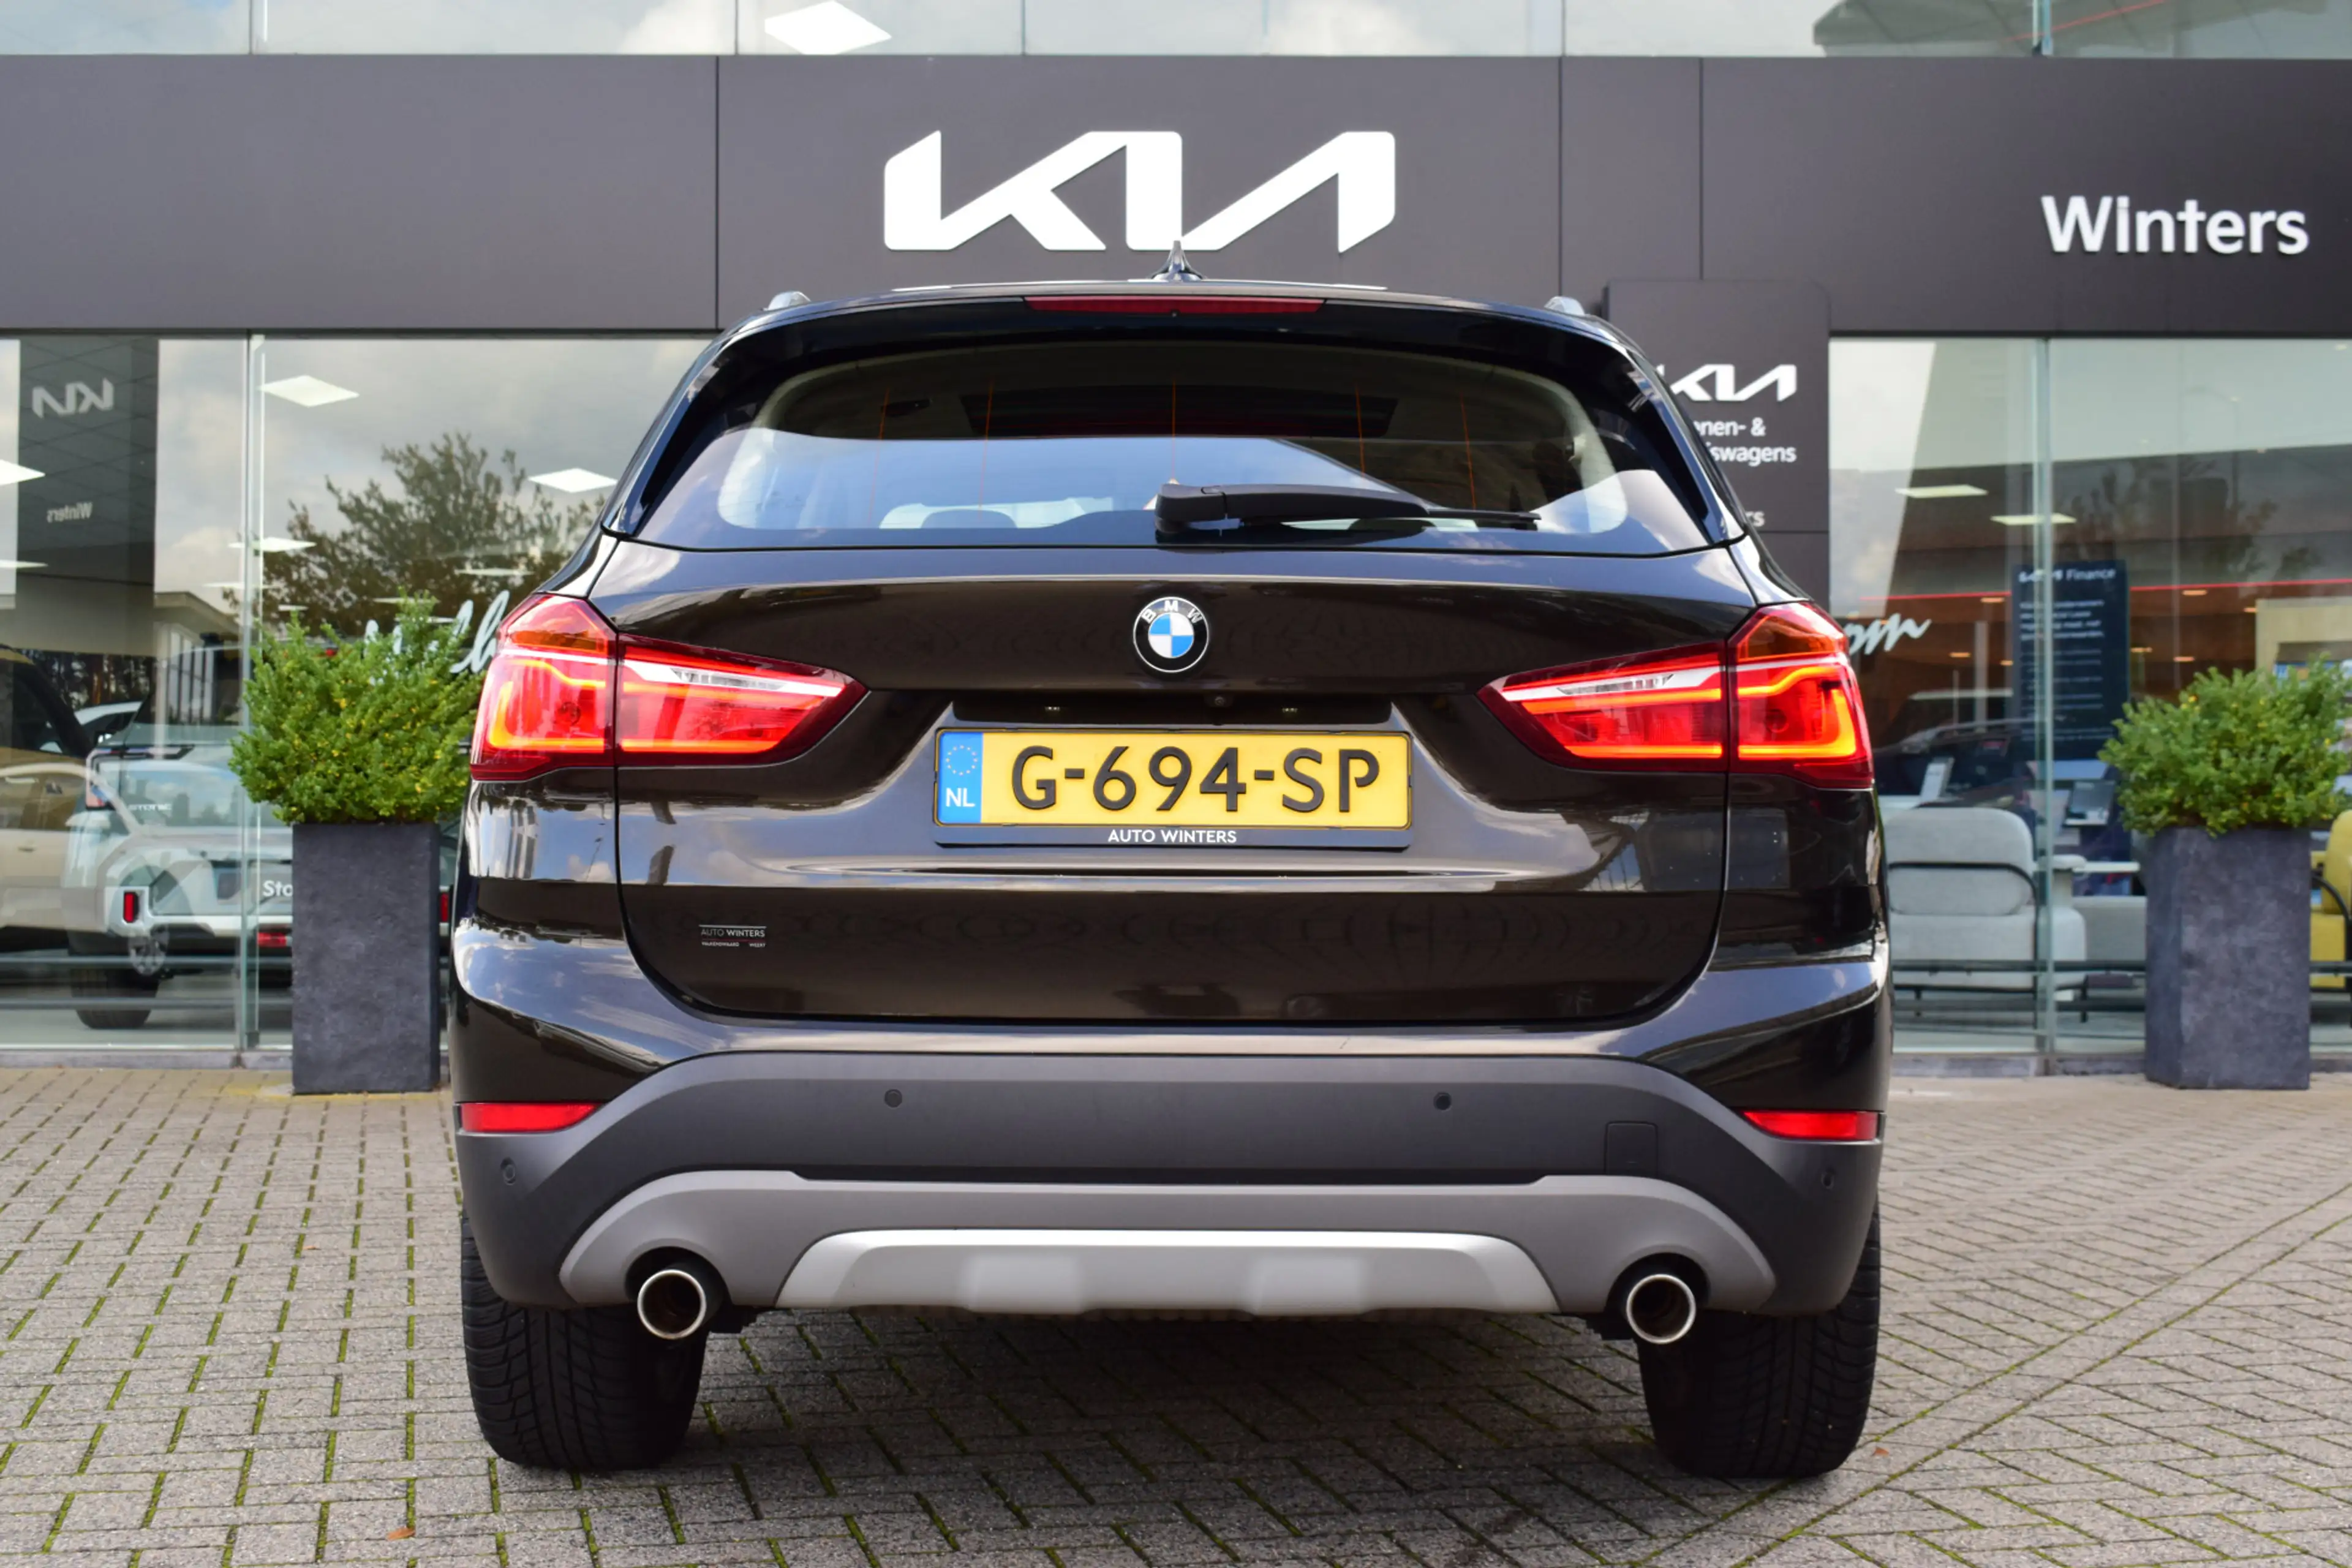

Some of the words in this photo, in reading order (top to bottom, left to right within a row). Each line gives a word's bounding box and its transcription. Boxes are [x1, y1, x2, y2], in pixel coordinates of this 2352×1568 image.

[884, 130, 1395, 253] KIA
[2041, 195, 2310, 255] Winters
[1751, 417, 1766, 437] &
[1706, 442, 1797, 467] swagens
[2066, 569, 2116, 581] Finance
[1141, 600, 1203, 624] BMW
[1011, 745, 1379, 813] G-694-SP
[946, 788, 975, 807] NL
[1108, 830, 1155, 843] AUTO
[1160, 830, 1237, 844] WINTERS
[262, 880, 293, 897] Sto
[726, 929, 766, 938] WINTERS
